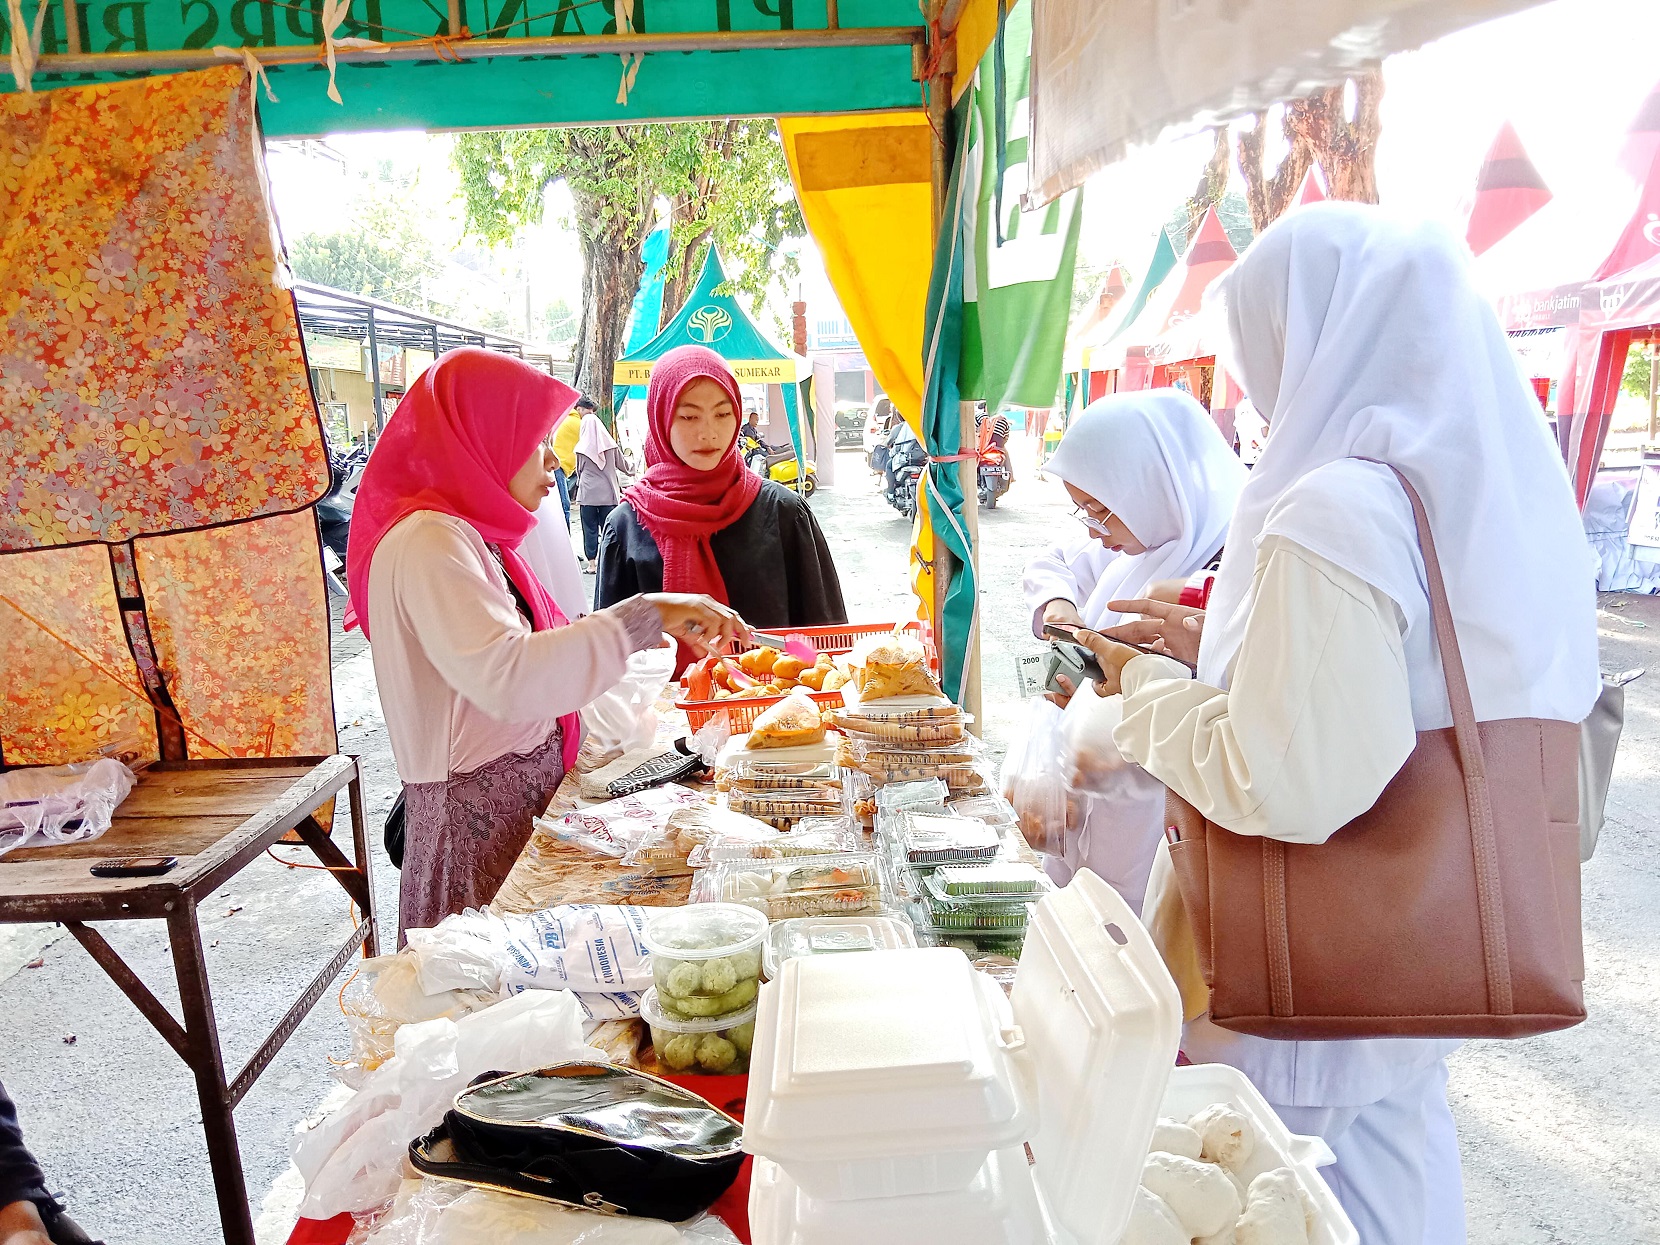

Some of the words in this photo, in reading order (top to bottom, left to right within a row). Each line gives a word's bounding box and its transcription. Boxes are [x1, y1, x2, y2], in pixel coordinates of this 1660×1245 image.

[1533, 293, 1580, 314] bankjatim
[628, 369, 643, 379] PT.
[734, 366, 781, 378] SUMEKAR
[1022, 656, 1040, 665] 2000
[594, 938, 614, 978] INDONESIA
